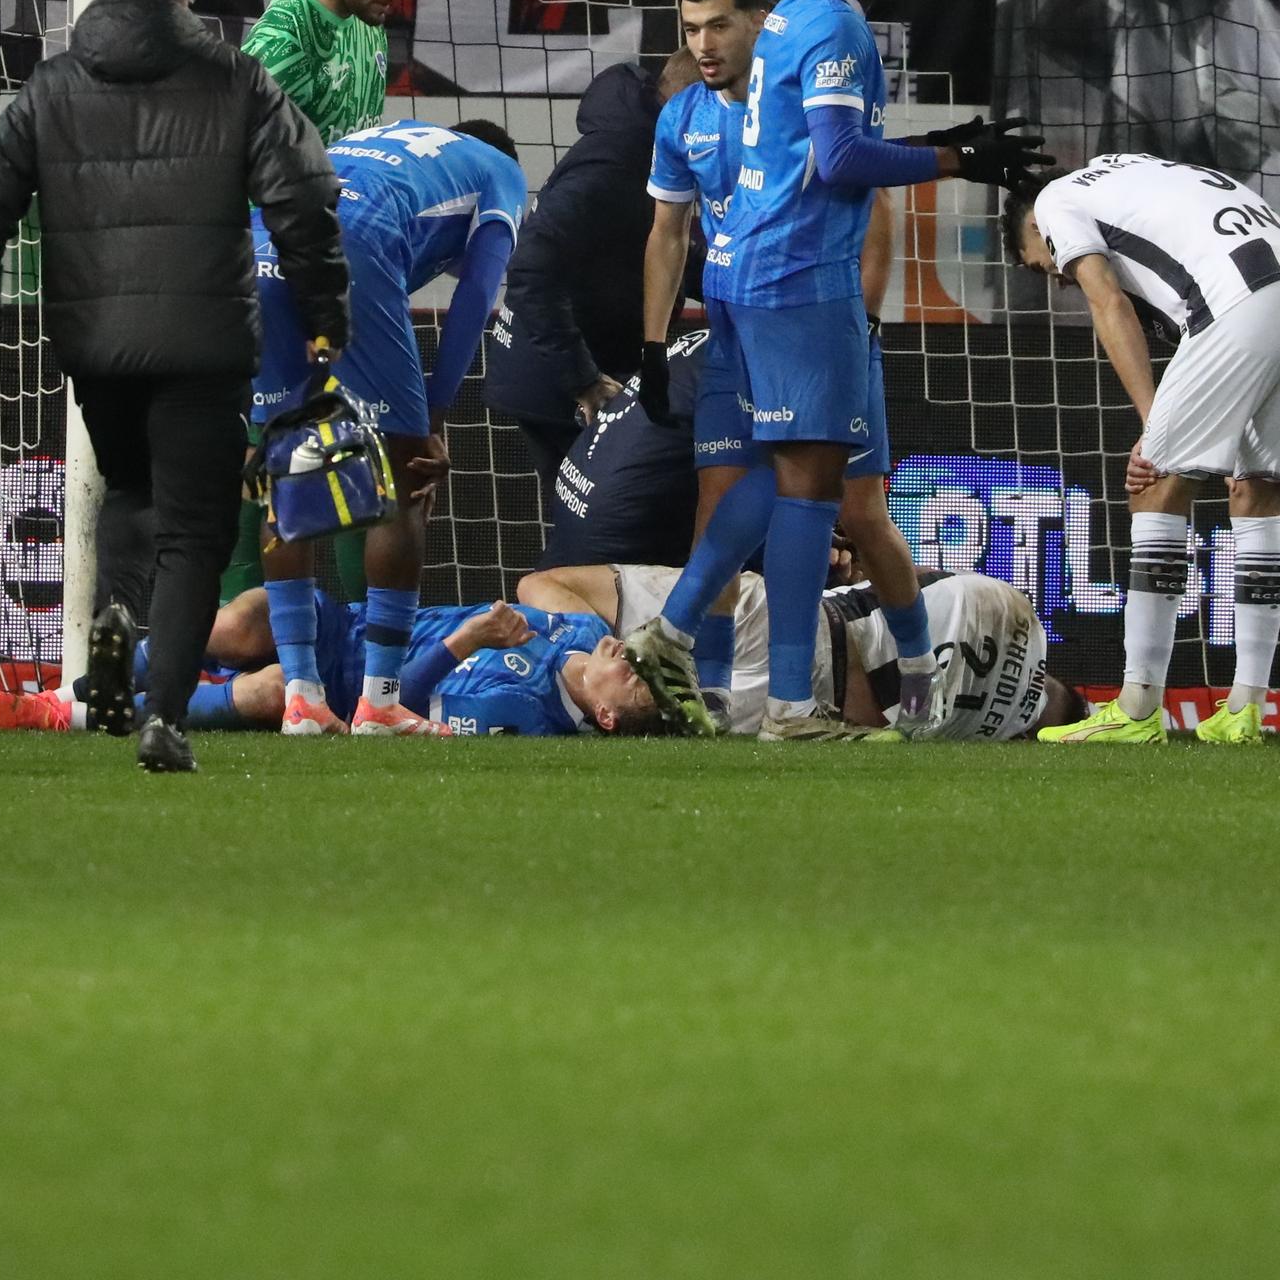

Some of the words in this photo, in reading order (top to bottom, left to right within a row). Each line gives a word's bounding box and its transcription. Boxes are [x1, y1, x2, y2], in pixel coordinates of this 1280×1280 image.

[815, 58, 854, 78] STAR
[697, 436, 743, 455] cegeka
[560, 455, 596, 497] OUSSAINT
[953, 634, 1000, 712] 21
[975, 618, 1031, 739] SCHEIDLER
